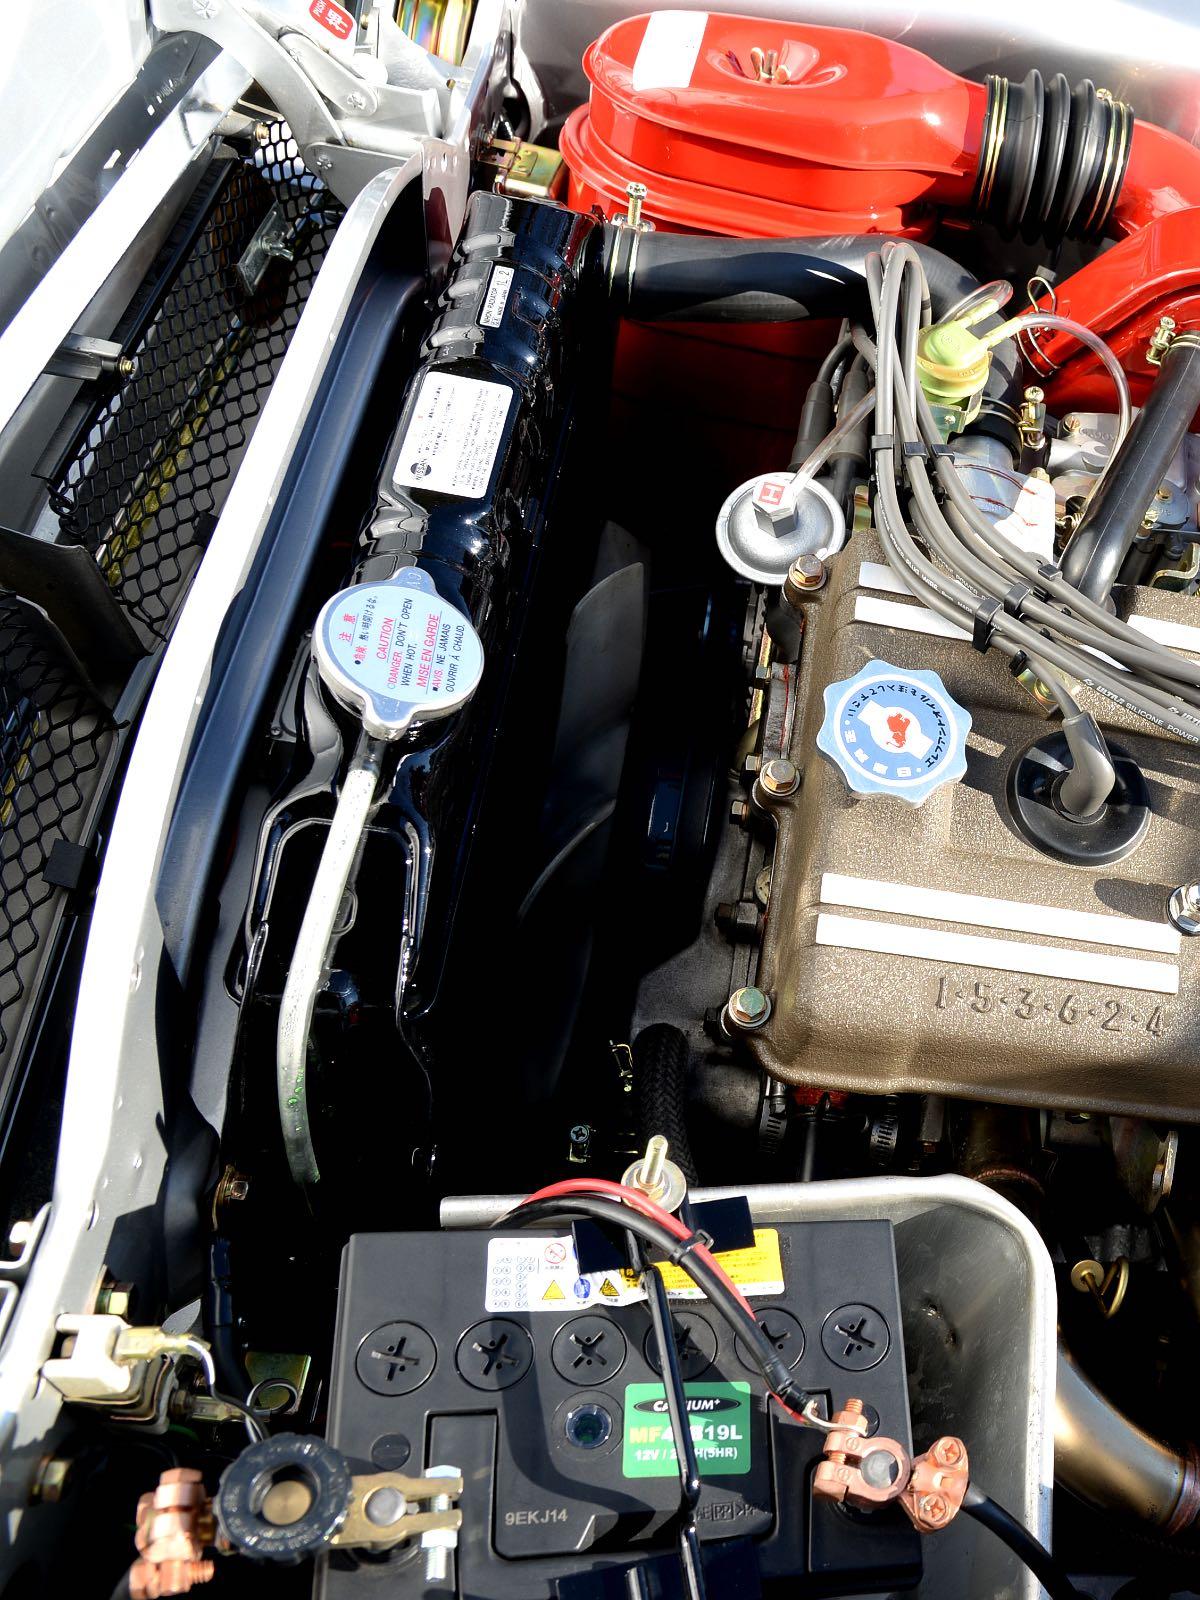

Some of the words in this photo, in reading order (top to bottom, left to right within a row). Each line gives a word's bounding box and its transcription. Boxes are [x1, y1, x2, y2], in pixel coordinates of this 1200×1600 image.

[415, 458, 428, 480] NISSAN
[394, 622, 408, 647] DON'T
[401, 598, 414, 619] OPEN
[424, 613, 441, 646] GARDE
[376, 617, 395, 660] CAUTION
[438, 623, 451, 653] JAMAIS
[400, 662, 414, 686] WHEN
[407, 643, 418, 661] HOT.
[421, 649, 433, 662] EN
[436, 653, 447, 665] NE
[446, 662, 458, 693] OUVRIR
[452, 624, 466, 652] CHAUD.
[416, 664, 431, 688] MISE
[1126, 701, 1164, 727] SILICONE
[1167, 724, 1200, 744] POWER
[653, 1398, 720, 1412] CAIUM+
[629, 1424, 742, 1444] MF4B19L
[636, 1449, 659, 1461] 12V
[505, 1508, 568, 1526] 9EKJ14
